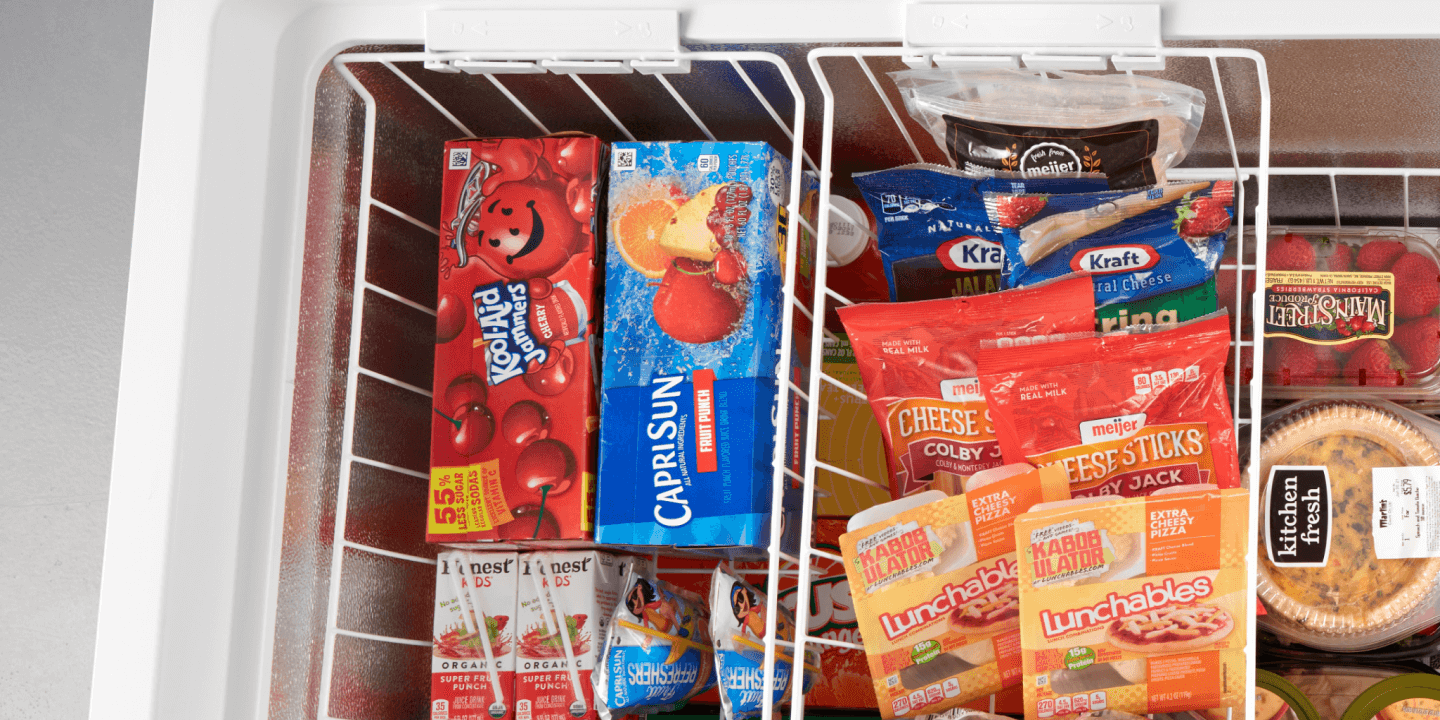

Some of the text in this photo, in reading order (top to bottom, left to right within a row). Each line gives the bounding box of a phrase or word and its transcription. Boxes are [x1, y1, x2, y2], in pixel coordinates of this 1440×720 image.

[700, 158, 708, 168] 60
[1031, 148, 1065, 163] fresh from
[1027, 160, 1075, 177] meijer
[962, 244, 1001, 264] Kra
[1089, 252, 1140, 270] Kraft
[1122, 273, 1172, 292] Cheese
[1268, 293, 1319, 305] PRODUCE
[507, 283, 546, 364] Jammers
[536, 304, 553, 339] CHERRY
[472, 287, 524, 385] Kool-Aid
[907, 345, 929, 353] MILK
[952, 379, 982, 397] mei
[1020, 388, 1067, 401] REAL MILK
[1040, 382, 1058, 390] WITH
[697, 389, 713, 453] FRUIT PUNCH
[898, 406, 979, 437] CHEESE
[1092, 418, 1138, 436] meijer
[677, 414, 692, 486] ALL NATURAL INGREDIENTS
[924, 443, 984, 461] COLBY
[1038, 429, 1203, 484] EESE STICKS
[936, 460, 952, 469] COLBY
[1129, 469, 1183, 491] JACK
[1403, 479, 1412, 495] $5.79
[434, 475, 456, 524] 55%
[454, 473, 467, 529] LESS SUGAR
[489, 479, 506, 515] VITAMIN
[972, 490, 1010, 508] EXTRA
[973, 496, 1017, 516] CHEESY
[975, 508, 1010, 525] PIZZA
[1150, 509, 1189, 521] EXTRA
[1150, 517, 1195, 530] CHEESY
[1278, 475, 1298, 557] kitchen
[1300, 486, 1320, 545] fresh
[1150, 526, 1186, 539] PIZZA
[859, 526, 926, 569] KABOB
[1032, 530, 1101, 560] KABOB
[863, 543, 935, 584] ULATOR
[1033, 547, 1105, 578] ULATOR
[874, 558, 934, 587] LUNCHABLES.COM
[1042, 564, 1104, 583] LUNCHABLES.COM
[462, 576, 492, 588] KDS
[543, 576, 570, 588] KDS
[880, 558, 1018, 640] Lunchable
[1042, 578, 1210, 636] Lunchables
[913, 640, 932, 652] 15g
[1068, 647, 1087, 656] 15g
[441, 661, 502, 670] ORGANC
[524, 660, 582, 669] ORGANC
[915, 650, 941, 665] Protein
[1068, 658, 1094, 670] Protein
[440, 675, 471, 683] SUPER
[523, 675, 551, 683] SUPER
[628, 662, 697, 685] REFRESHERS
[453, 683, 487, 691] PUNCH
[436, 702, 445, 711] 35
[519, 702, 529, 711] 35
[893, 697, 908, 709] 270
[1039, 701, 1052, 709] 270
